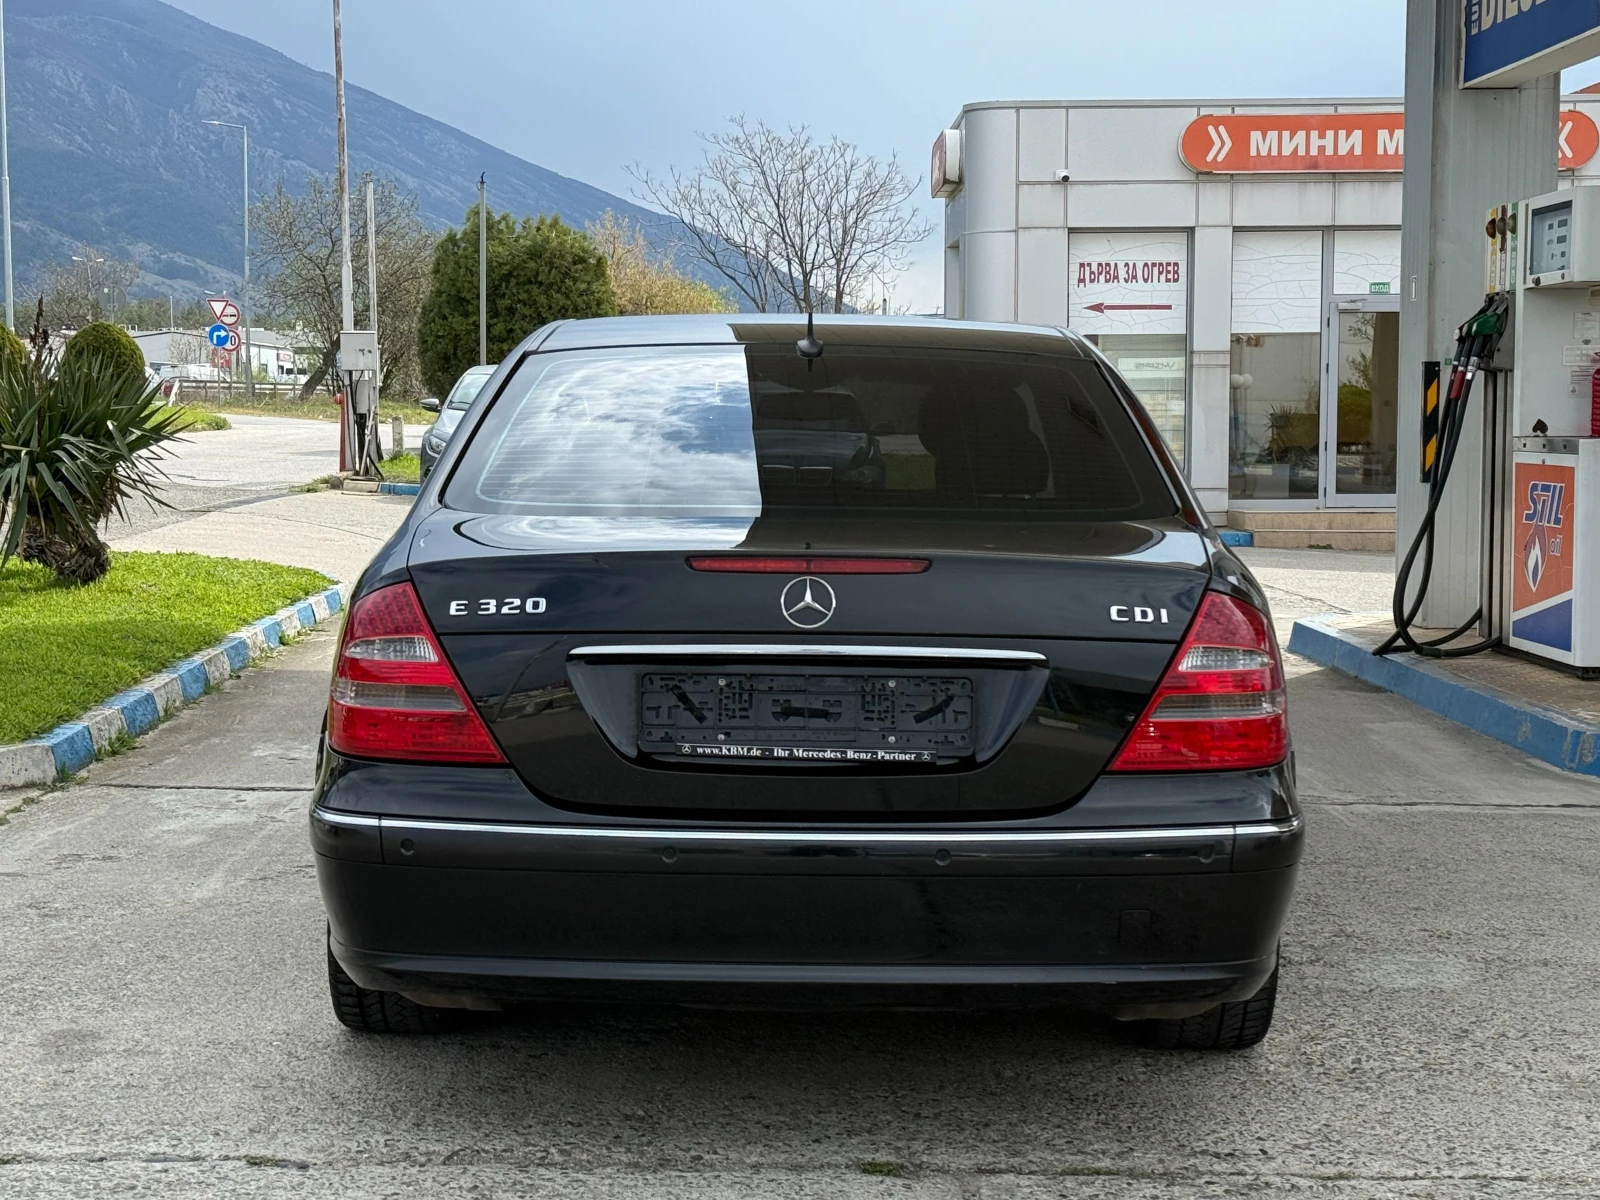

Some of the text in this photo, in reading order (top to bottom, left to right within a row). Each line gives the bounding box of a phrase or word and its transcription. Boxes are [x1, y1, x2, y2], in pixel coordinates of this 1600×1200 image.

[1250, 130, 1363, 156] МИНИ
[1078, 262, 1180, 288] ДЪРВА ЗА ОГРЕВ
[1371, 284, 1389, 293] ВХОД
[1550, 534, 1562, 556] oil
[449, 597, 547, 615] E 320
[1110, 605, 1169, 623] CDI
[696, 746, 762, 757] www.KBM.de
[773, 748, 790, 757] Ihr
